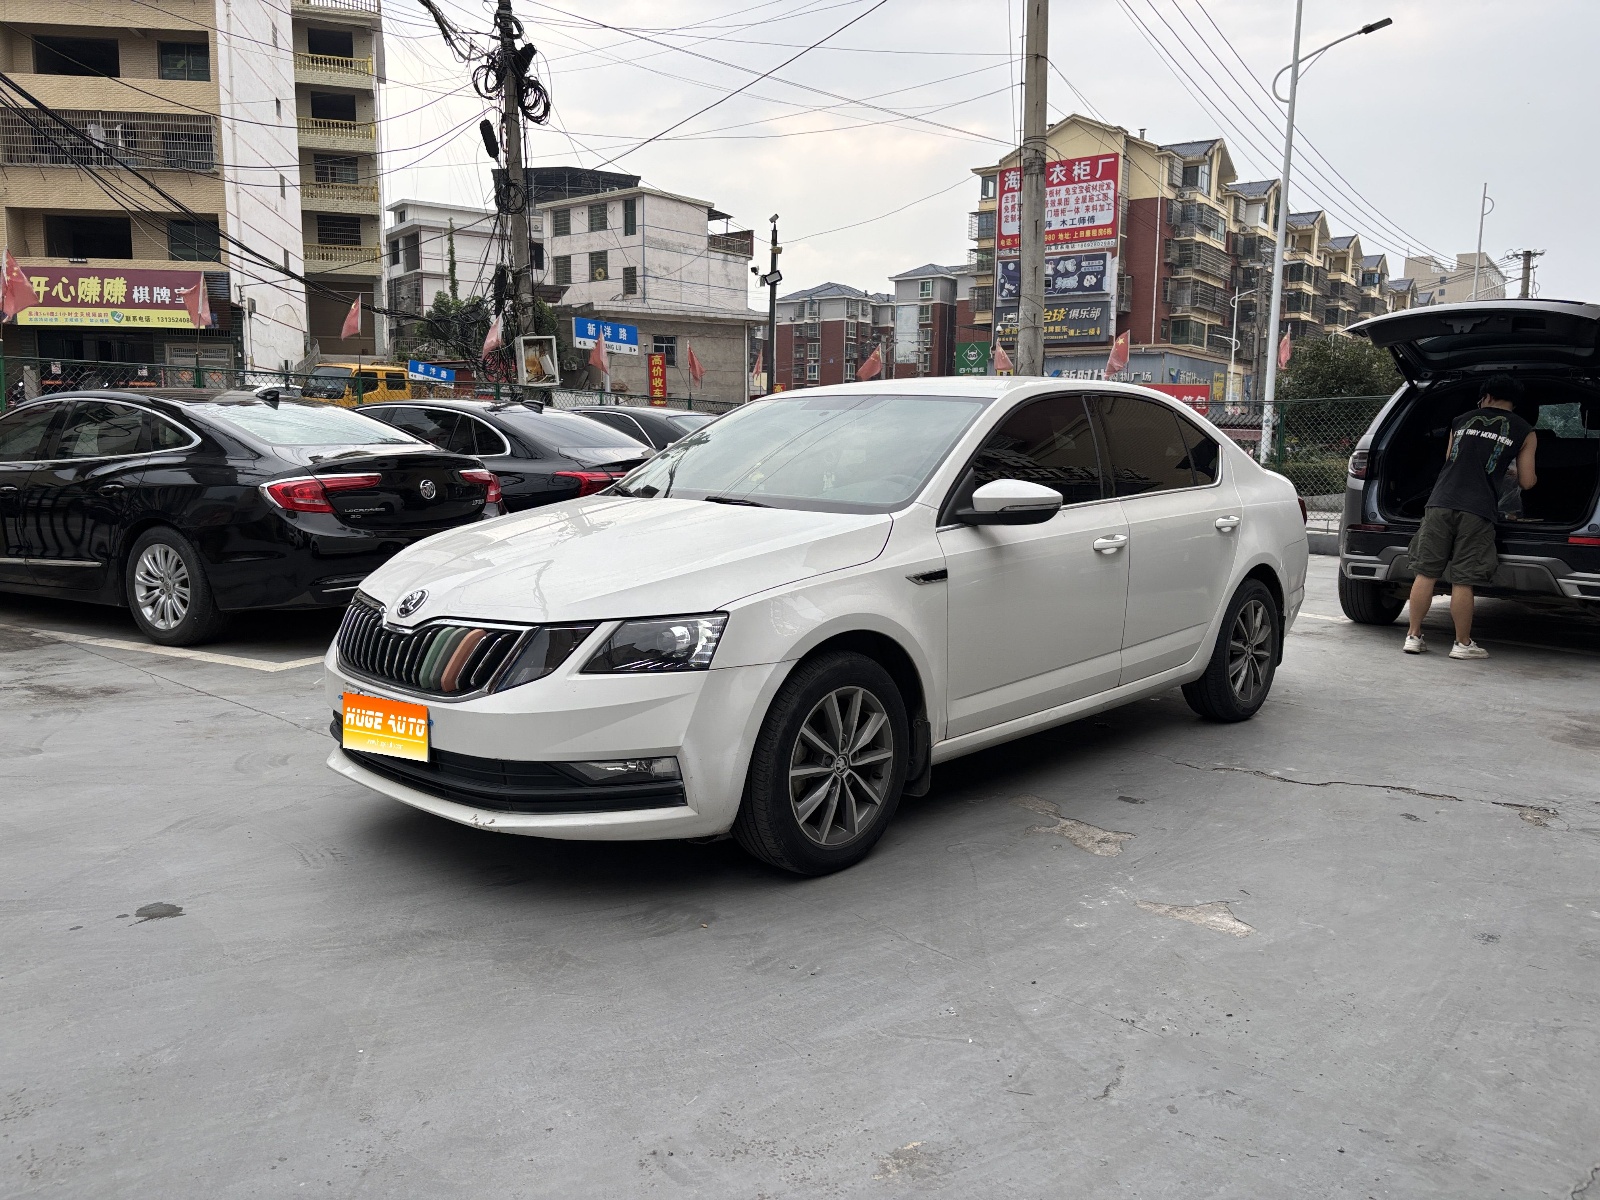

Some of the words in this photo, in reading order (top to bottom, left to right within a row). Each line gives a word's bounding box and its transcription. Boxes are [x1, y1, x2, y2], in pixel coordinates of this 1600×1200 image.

[1060, 215, 1095, 227] 木工师傅
[587, 322, 628, 341] 新洋路
[418, 364, 447, 379] 新洋路
[651, 355, 664, 398] 高价收车
